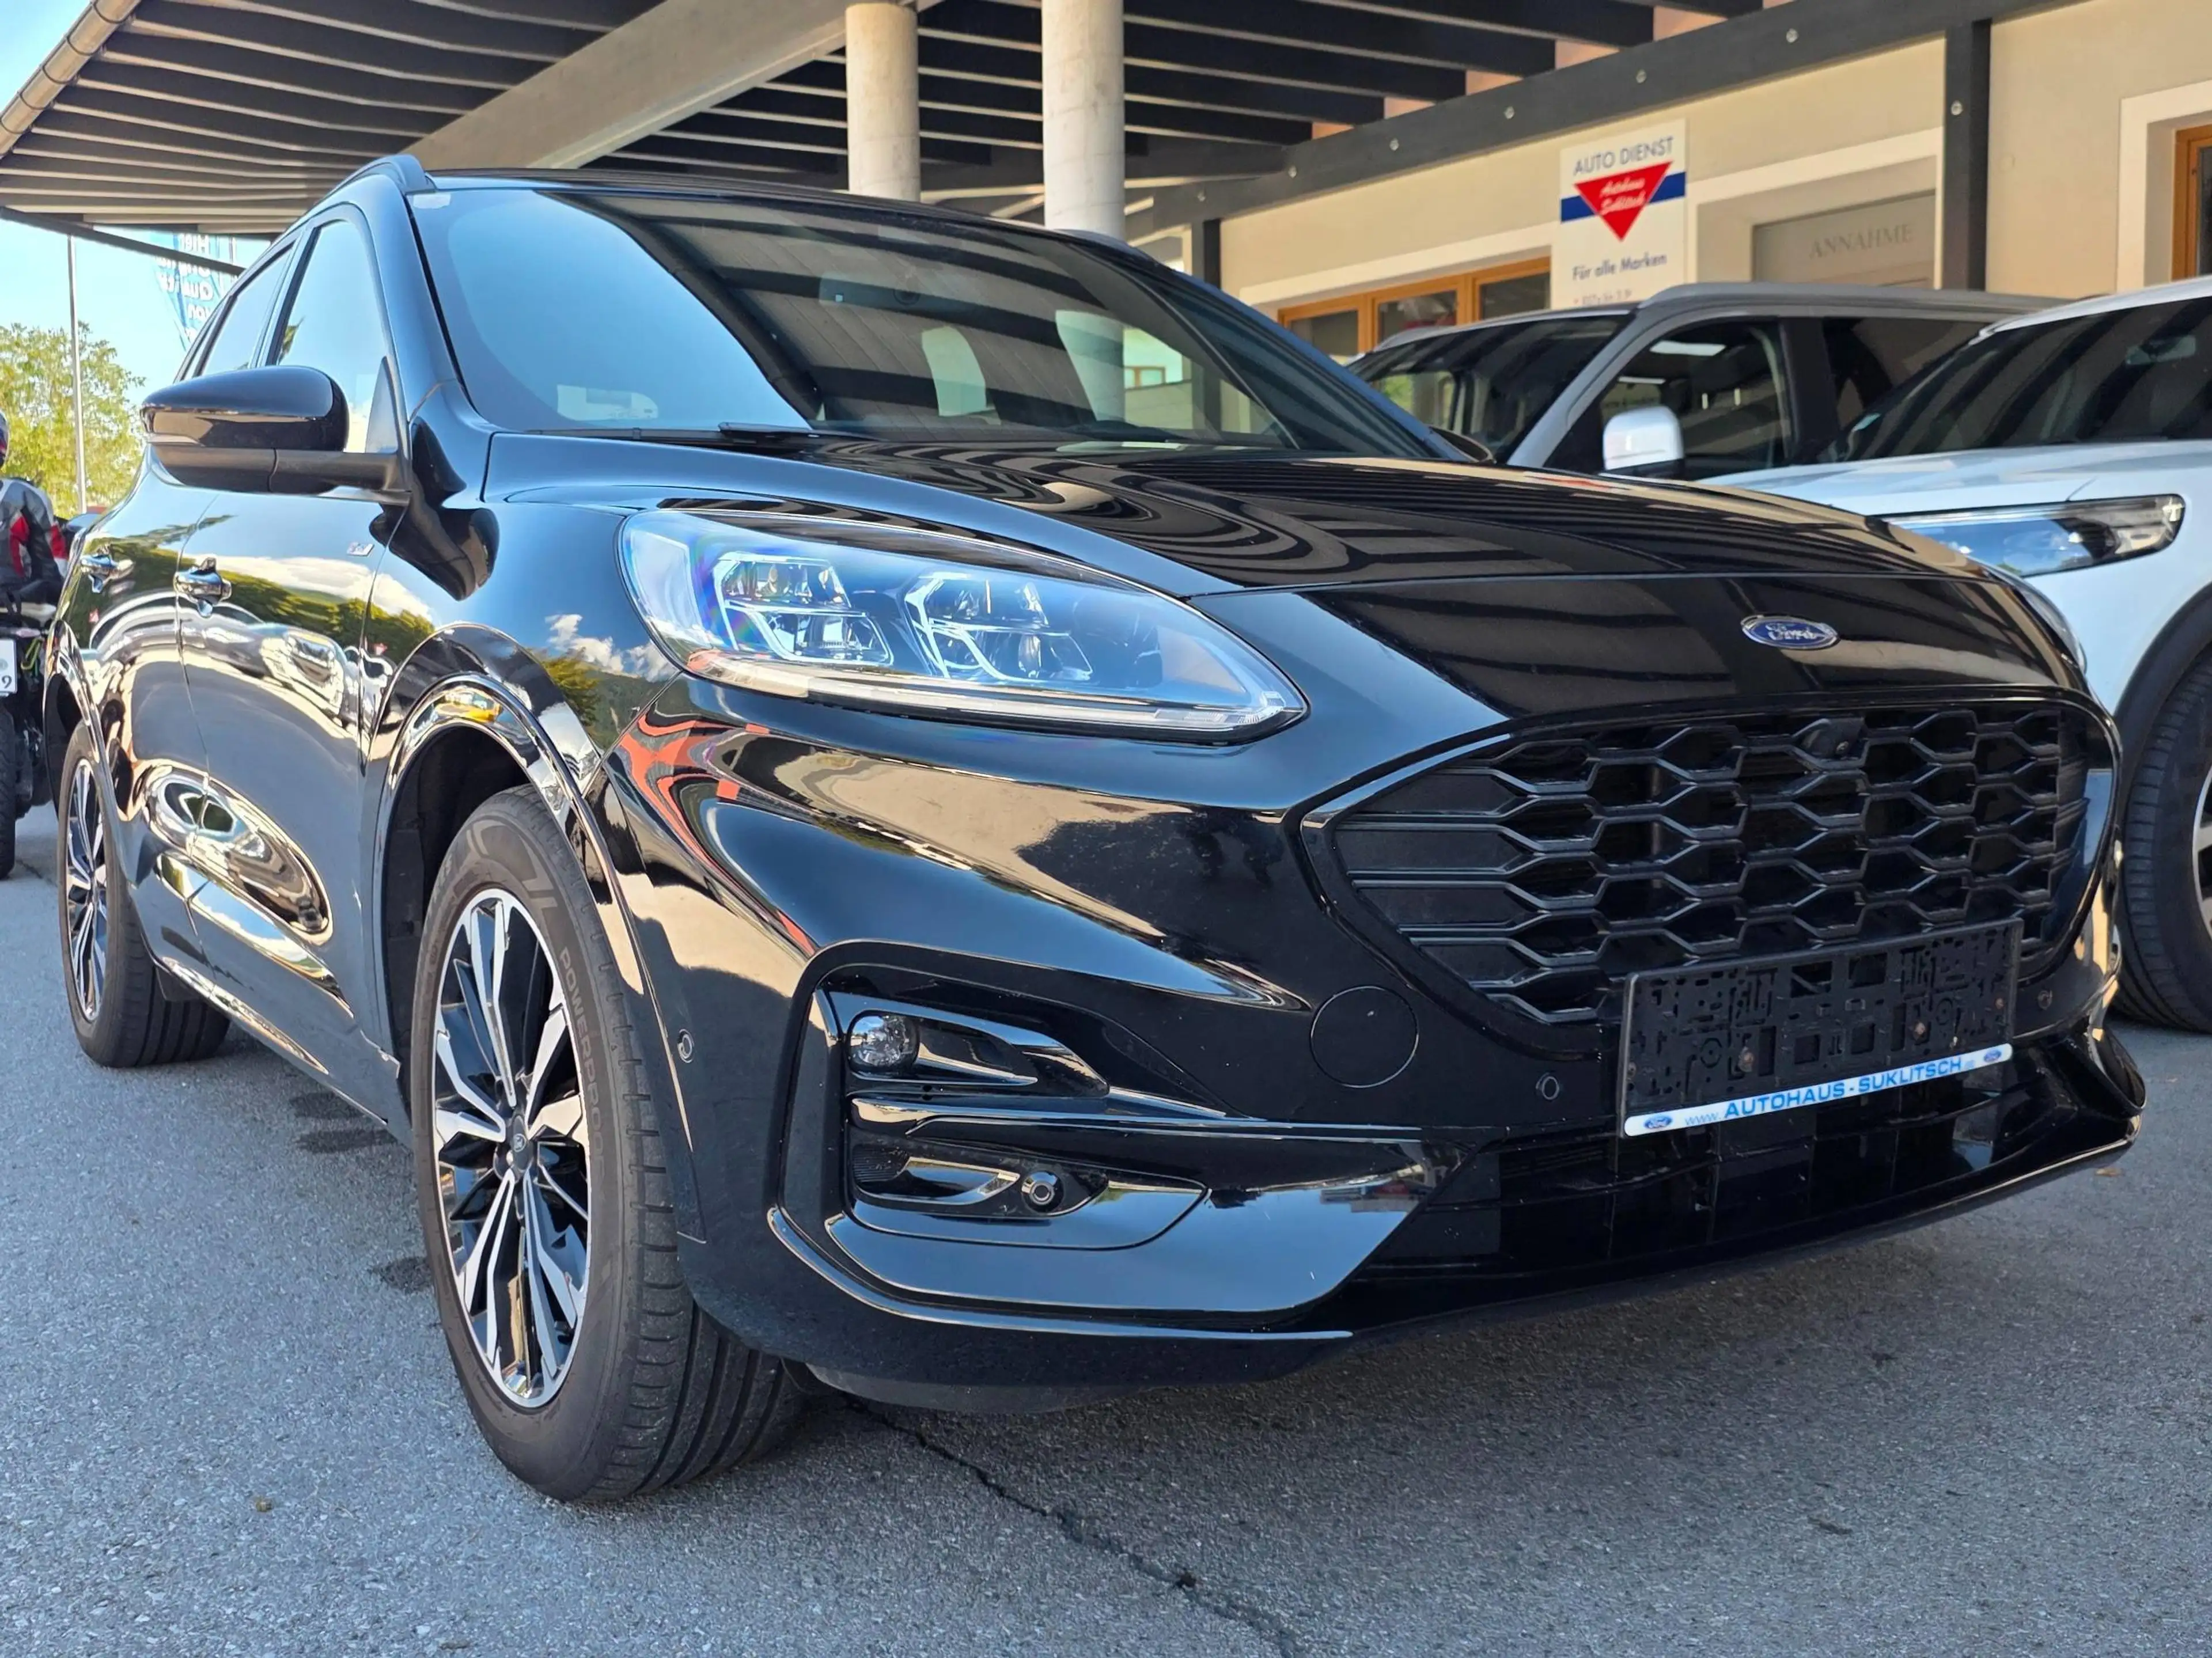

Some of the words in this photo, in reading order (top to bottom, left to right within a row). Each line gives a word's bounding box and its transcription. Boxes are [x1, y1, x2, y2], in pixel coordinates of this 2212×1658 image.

[1573, 151, 1615, 176] AUTO
[1620, 136, 1673, 165] DIENST
[1809, 223, 1913, 259] ANNAHME
[1573, 265, 1592, 281] Für
[1594, 259, 1616, 277] alle
[1620, 252, 1667, 272] Marken
